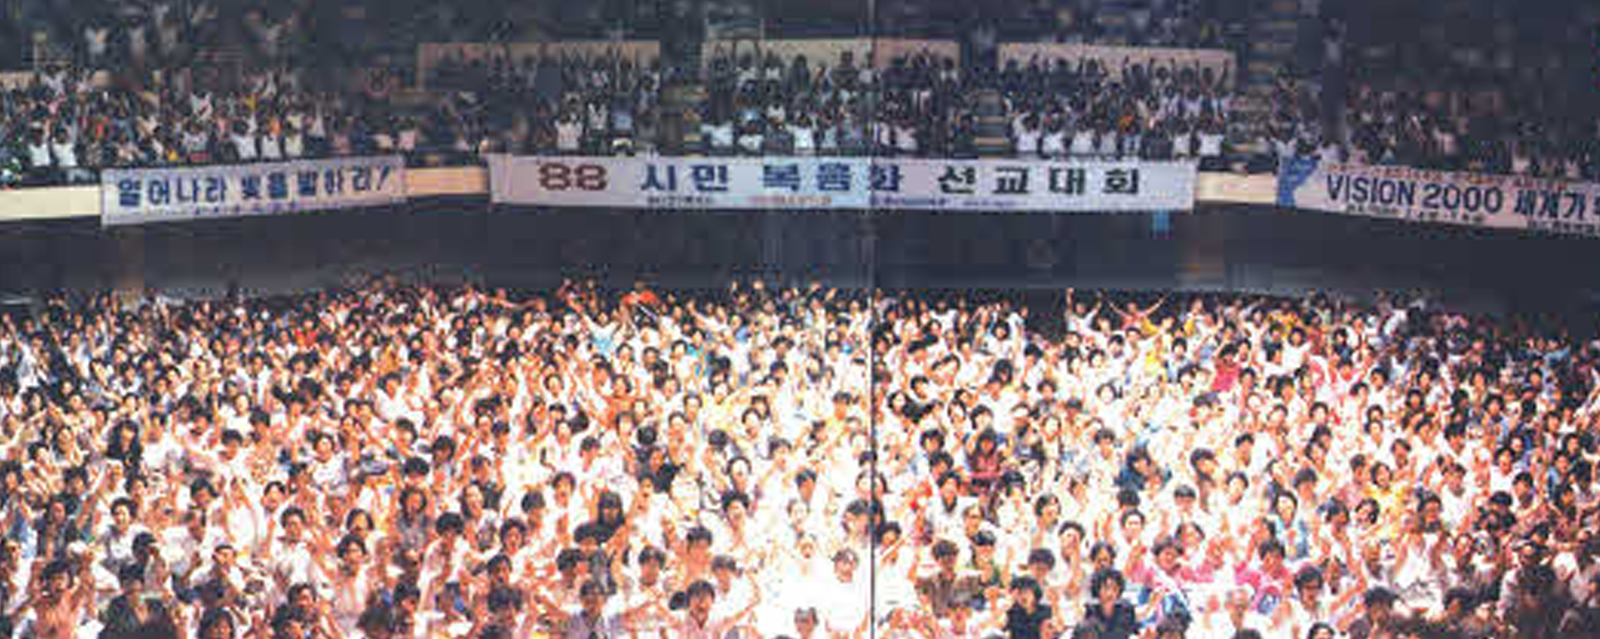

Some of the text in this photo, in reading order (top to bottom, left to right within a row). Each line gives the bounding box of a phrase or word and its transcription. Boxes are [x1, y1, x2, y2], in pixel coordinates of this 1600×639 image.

[640, 163, 729, 192] 시민
[761, 163, 904, 192] 복음화
[938, 165, 1140, 195] 선교대회
[1327, 174, 1416, 206] VISION
[1421, 183, 1503, 214] 2000
